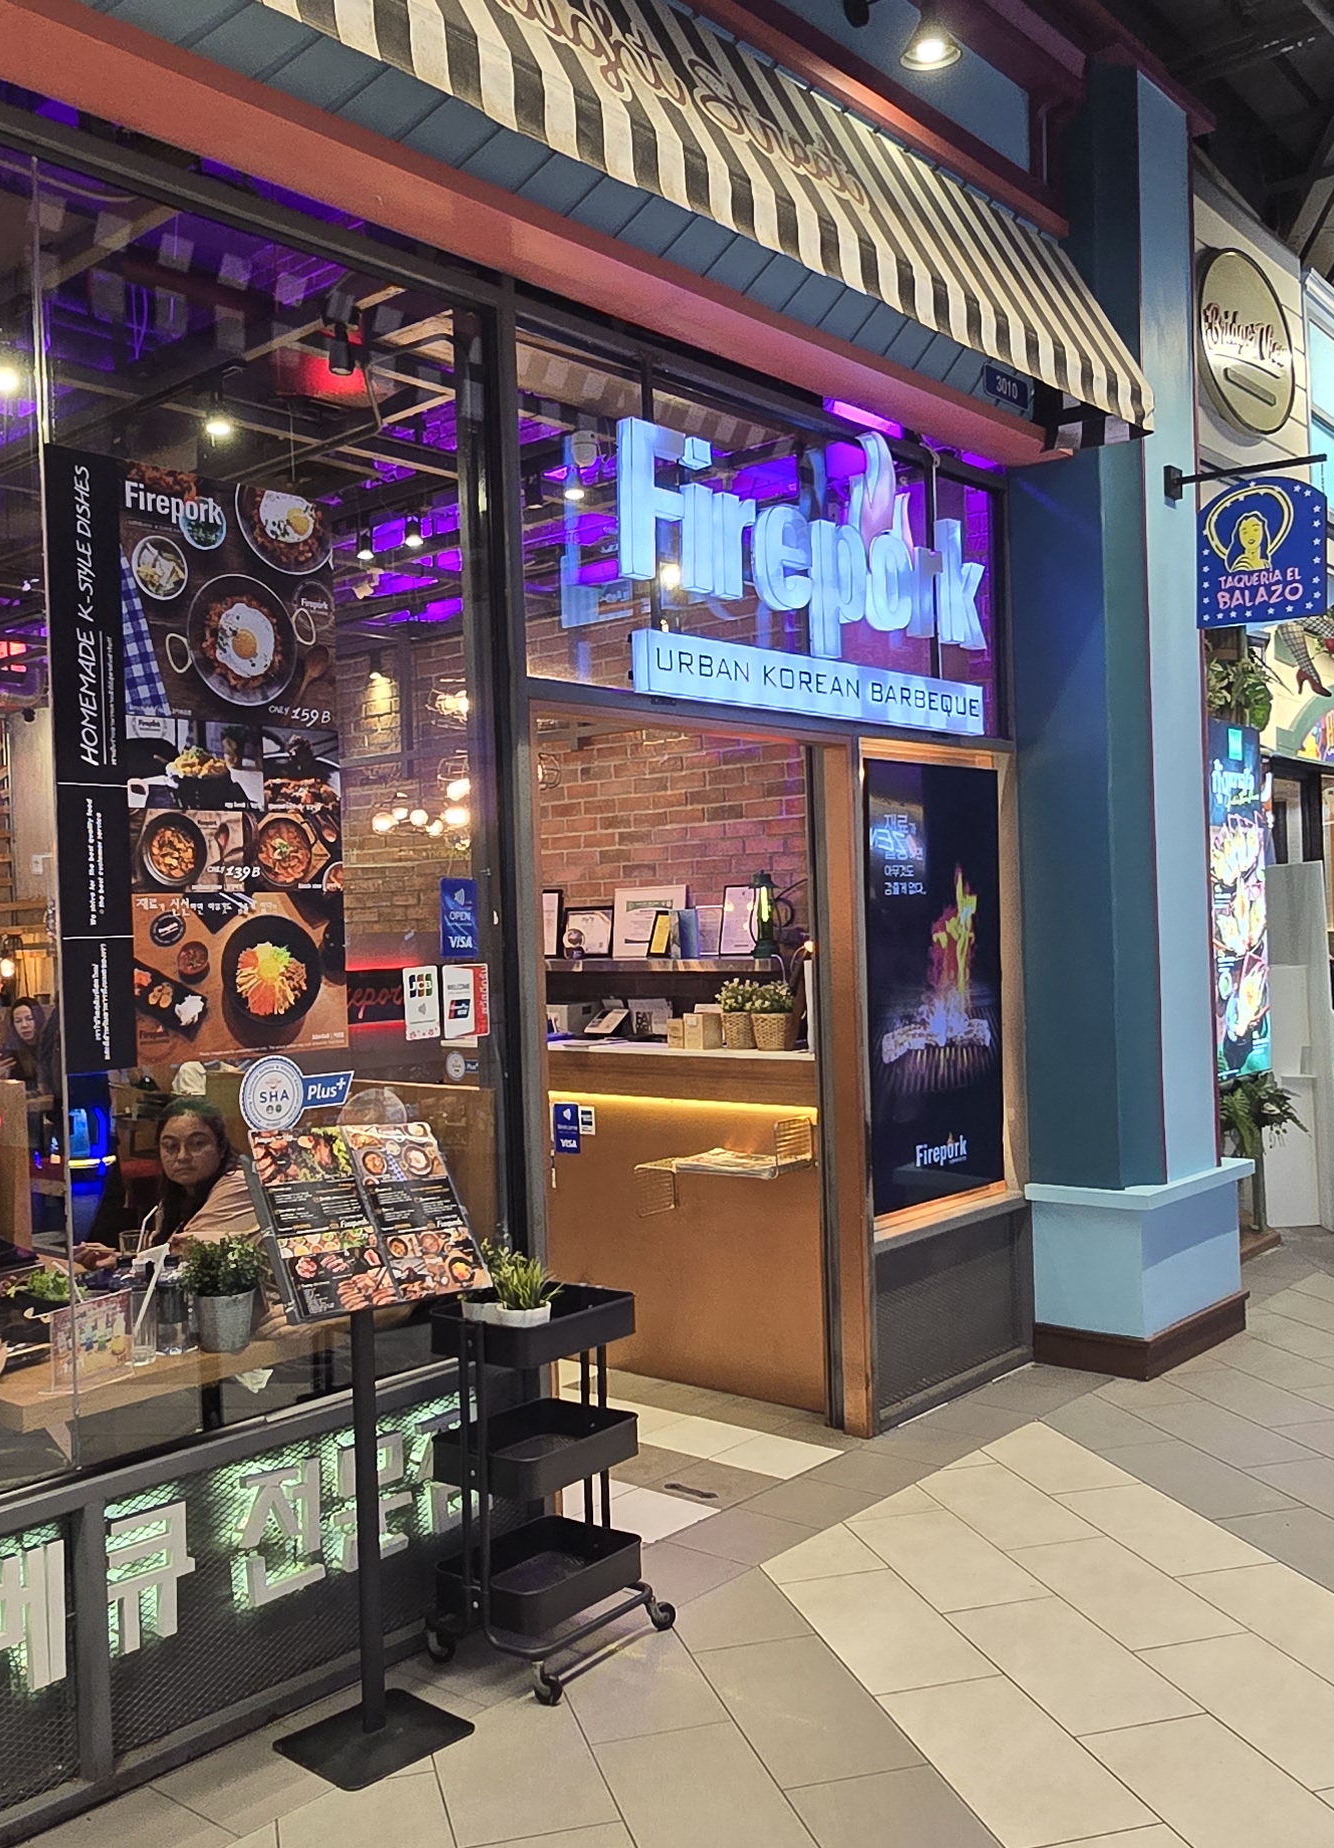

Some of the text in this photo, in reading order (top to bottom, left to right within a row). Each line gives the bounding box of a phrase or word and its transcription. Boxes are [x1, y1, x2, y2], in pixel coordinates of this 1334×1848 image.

[687, 57, 870, 206] Street
[1203, 302, 1257, 357] Bridge
[995, 375, 1020, 400] 3010
[124, 479, 222, 526] Firepork
[617, 417, 986, 658] Firepork
[1286, 567, 1302, 581] EL
[1217, 583, 1304, 610] BALAZO
[73, 464, 100, 766] HOMEMADE K-STYLE DISHES
[656, 647, 981, 719] URBAN KOREAN BARBEQUE
[268, 704, 332, 728] ONLY 159 B
[87, 845, 95, 862] best
[224, 865, 251, 882] 139
[449, 911, 472, 922] OPEN
[448, 936, 473, 949] VISA
[409, 977, 433, 994] JCB
[259, 1089, 290, 1104] SHA
[560, 1138, 578, 1148] VISA
[915, 1135, 968, 1168] Firepork
